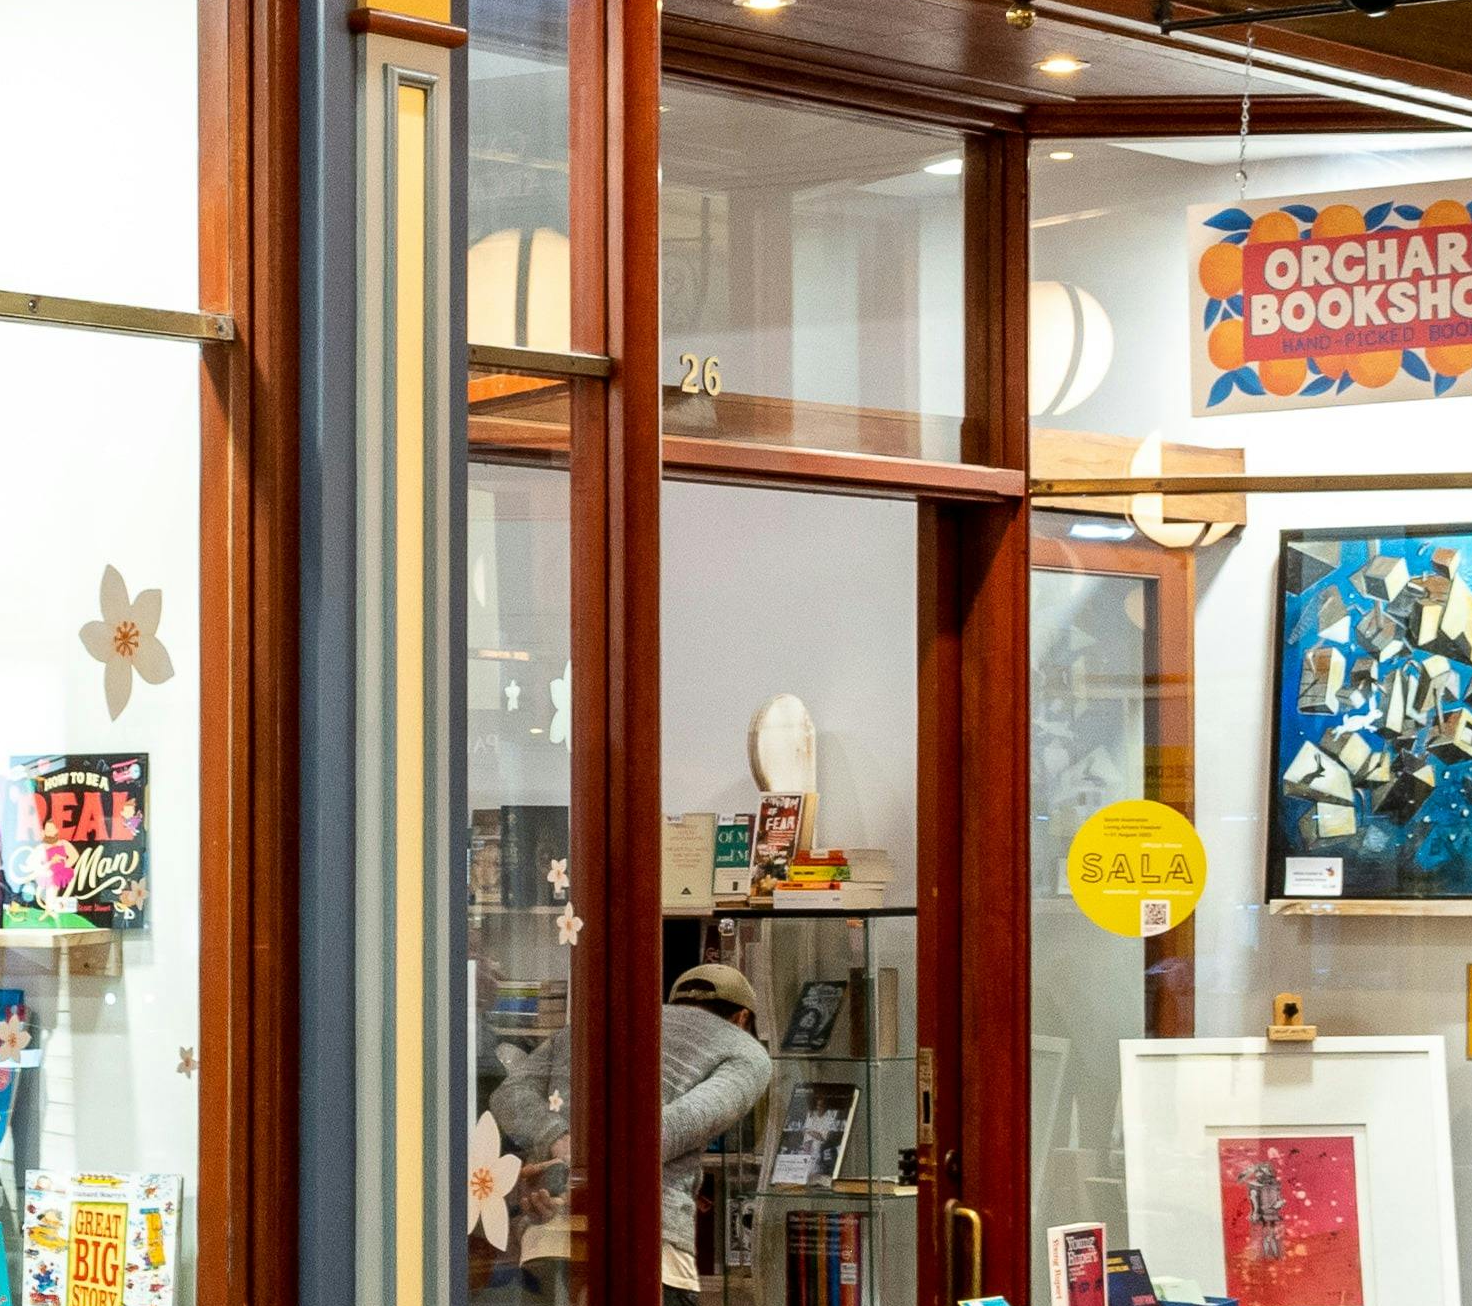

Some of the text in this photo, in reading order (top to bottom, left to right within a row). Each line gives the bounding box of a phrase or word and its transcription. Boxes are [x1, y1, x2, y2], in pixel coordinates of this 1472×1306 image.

[1281, 325, 1415, 354] HAND-PICKED
[680, 352, 722, 397] 26
[43, 773, 68, 792] HOW
[70, 773, 86, 787] TO
[16, 791, 138, 842] REAL
[765, 815, 795, 832] FEAR
[718, 830, 732, 844] Of
[66, 845, 130, 890] Man
[716, 848, 735, 862] and
[1081, 852, 1194, 885] SALA
[74, 1209, 121, 1240] GREAT
[73, 1238, 119, 1287] BIG
